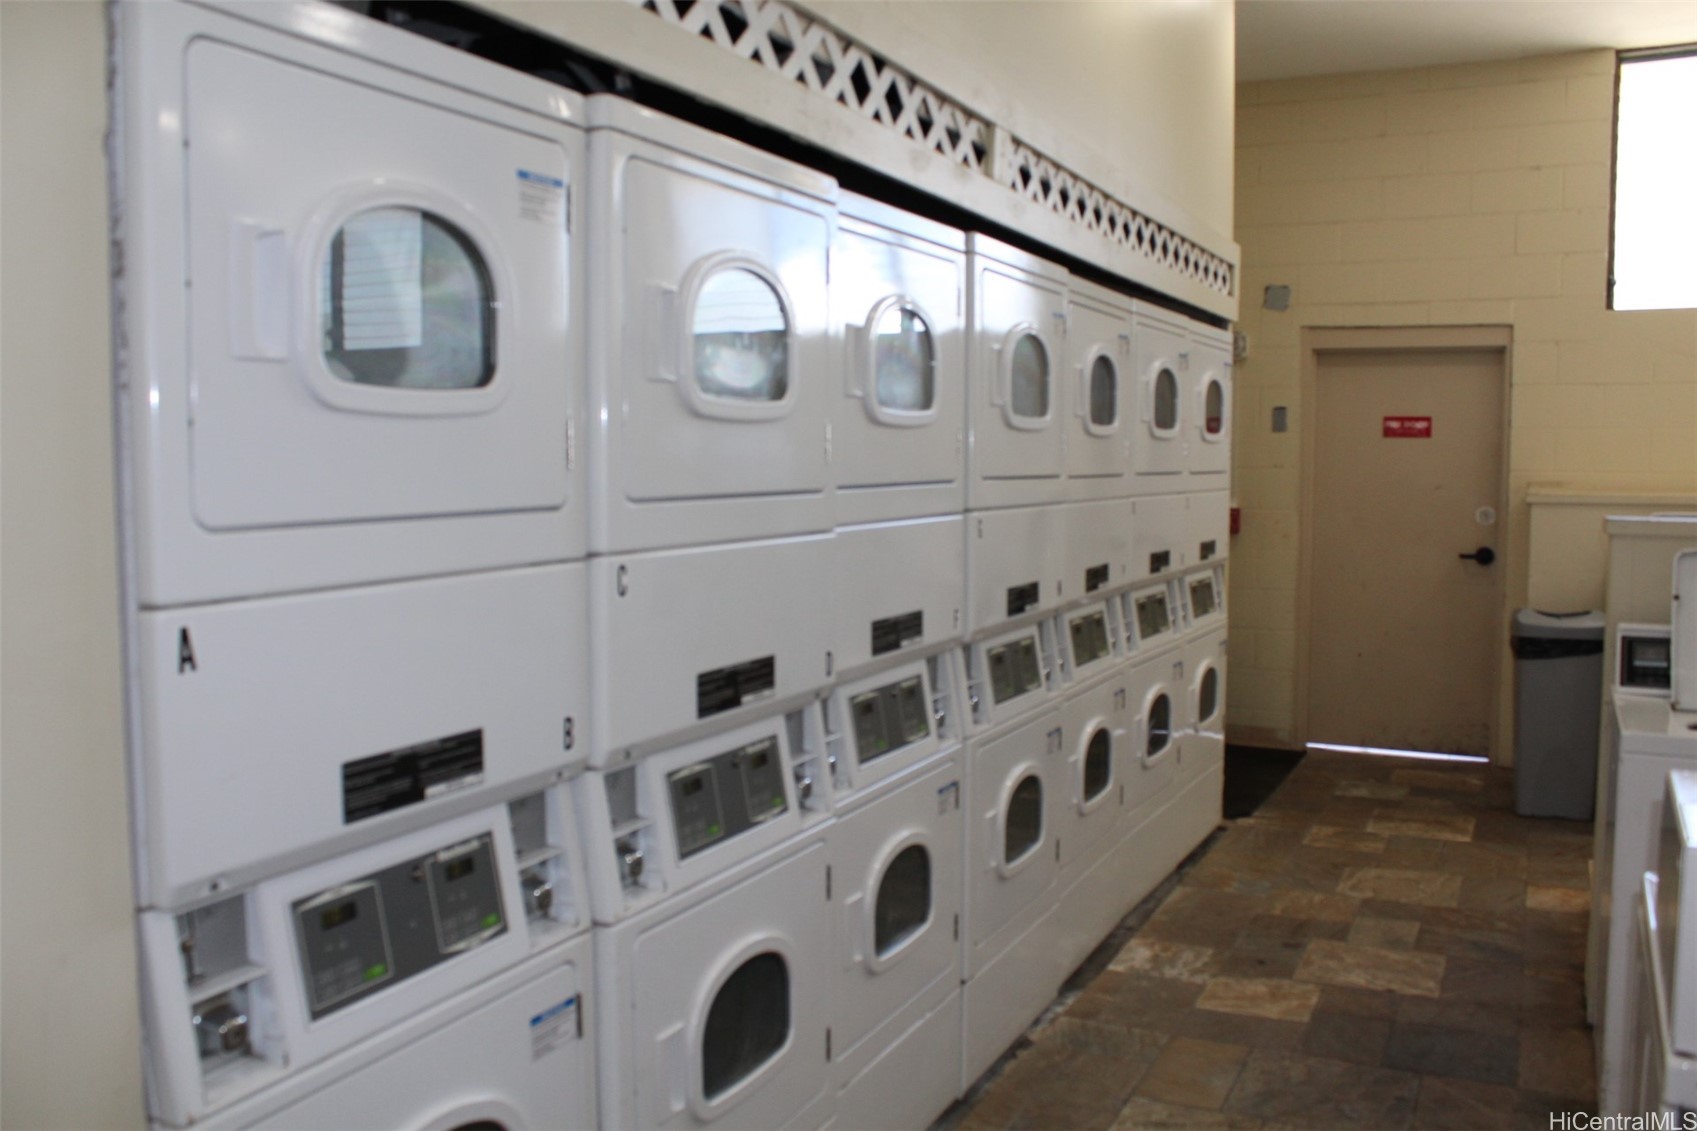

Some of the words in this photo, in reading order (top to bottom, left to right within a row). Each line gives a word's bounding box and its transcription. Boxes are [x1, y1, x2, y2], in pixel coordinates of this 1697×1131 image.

[617, 563, 629, 598] C
[178, 626, 198, 675] A
[563, 716, 575, 751] B
